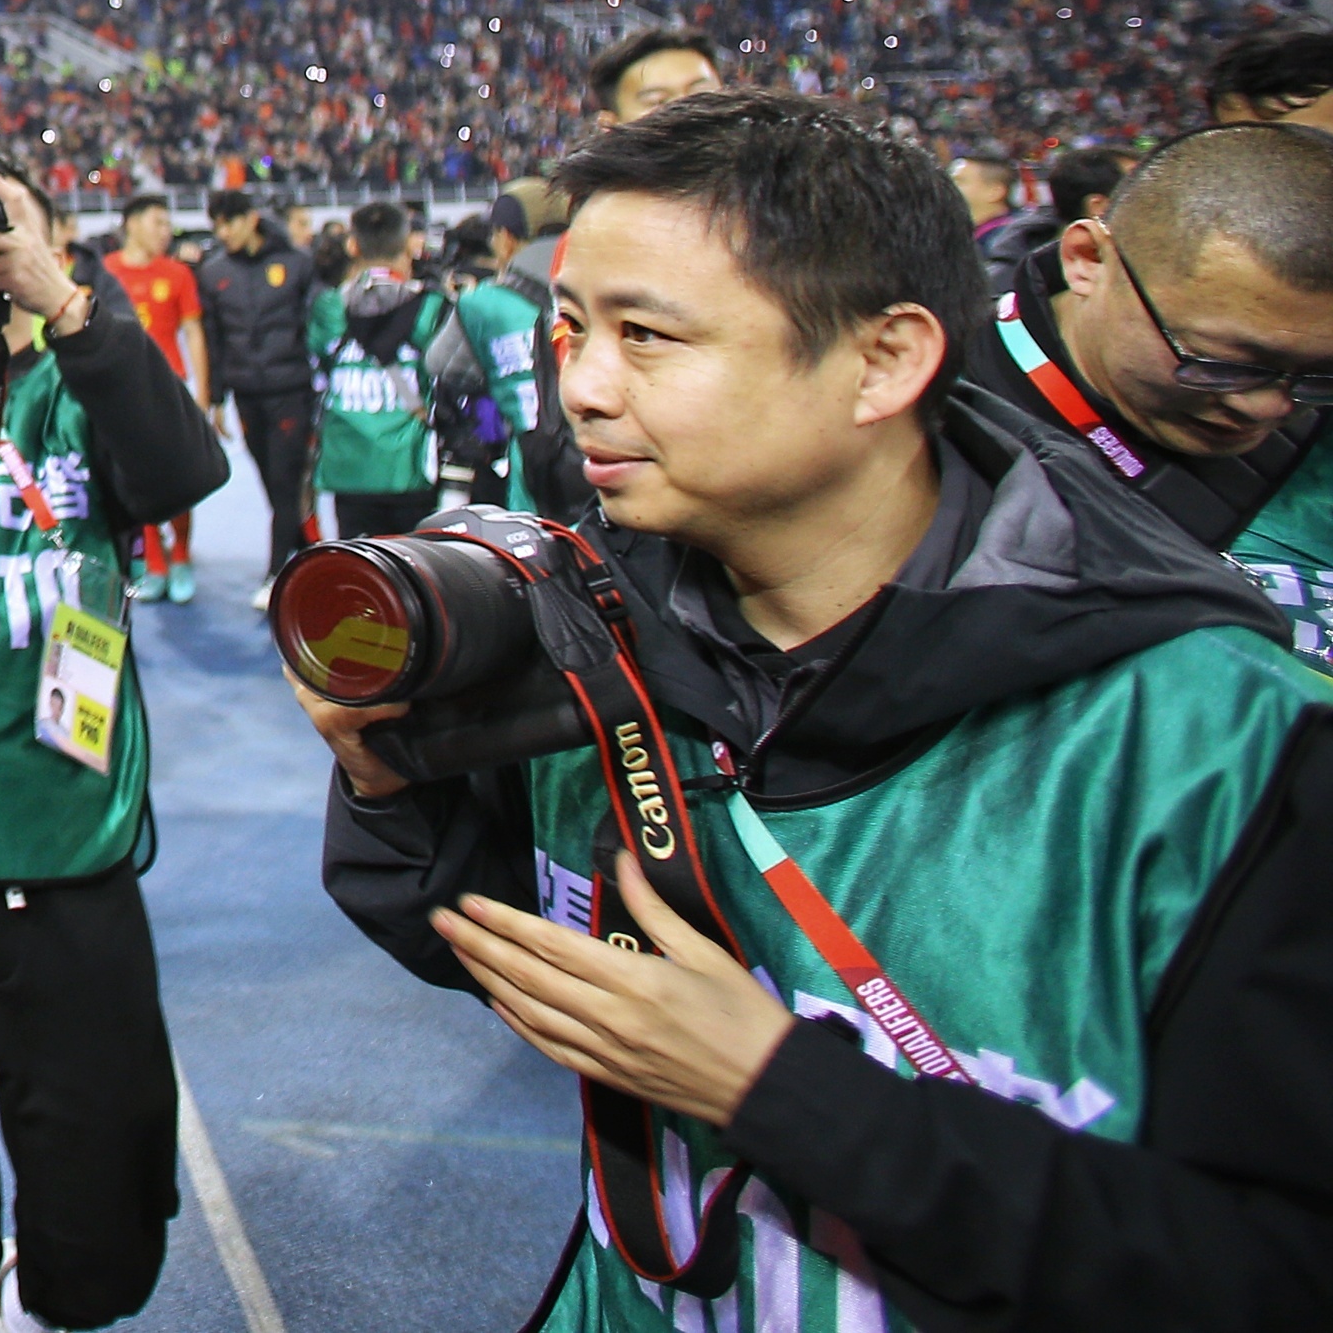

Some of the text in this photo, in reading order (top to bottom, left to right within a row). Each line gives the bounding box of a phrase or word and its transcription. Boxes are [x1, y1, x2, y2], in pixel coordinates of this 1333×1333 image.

[505, 530, 530, 544] EOS
[615, 721, 676, 861] Canon
[856, 977, 955, 1076] QUALIFIERS
